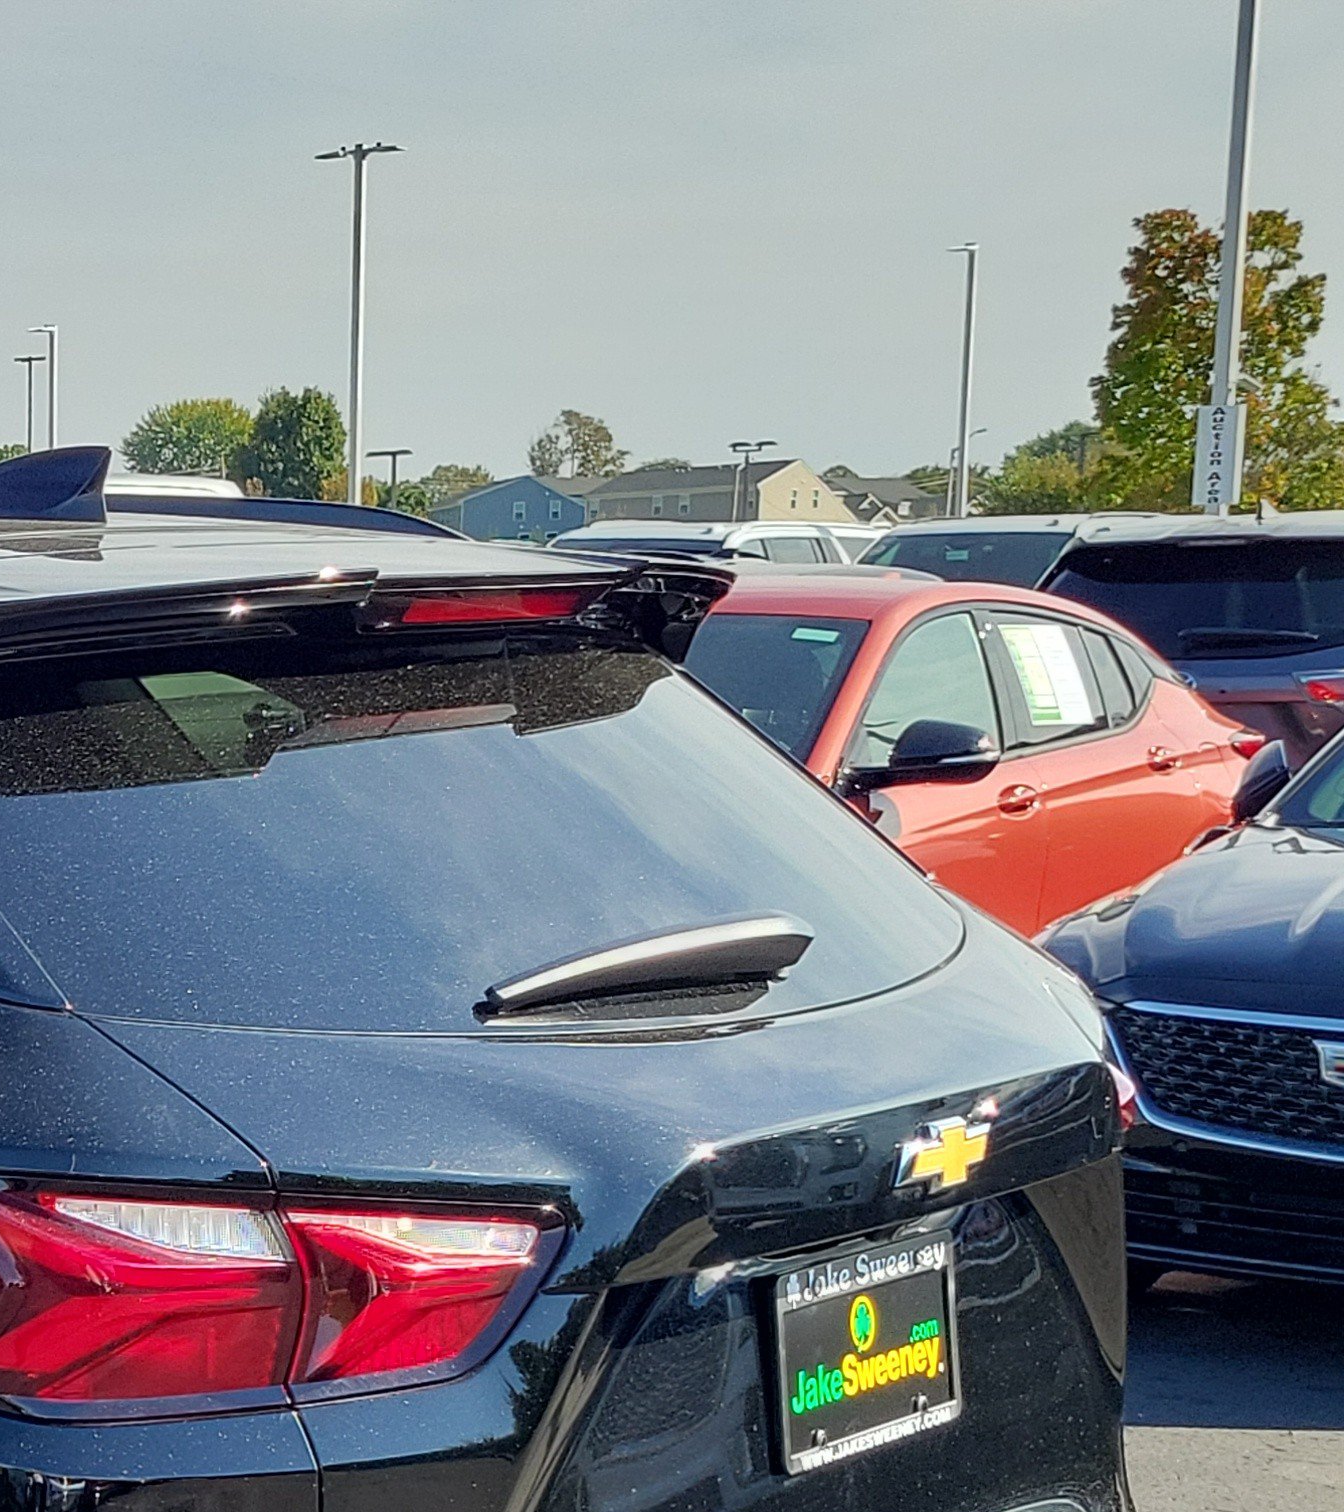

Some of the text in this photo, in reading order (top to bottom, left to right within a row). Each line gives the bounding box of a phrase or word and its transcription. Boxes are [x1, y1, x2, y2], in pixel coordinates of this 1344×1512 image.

[1206, 406, 1226, 504] Auction Area
[803, 1240, 947, 1301] Jake Sweeney
[798, 1407, 952, 1471] WWW.JAKESWEENEY.COM
